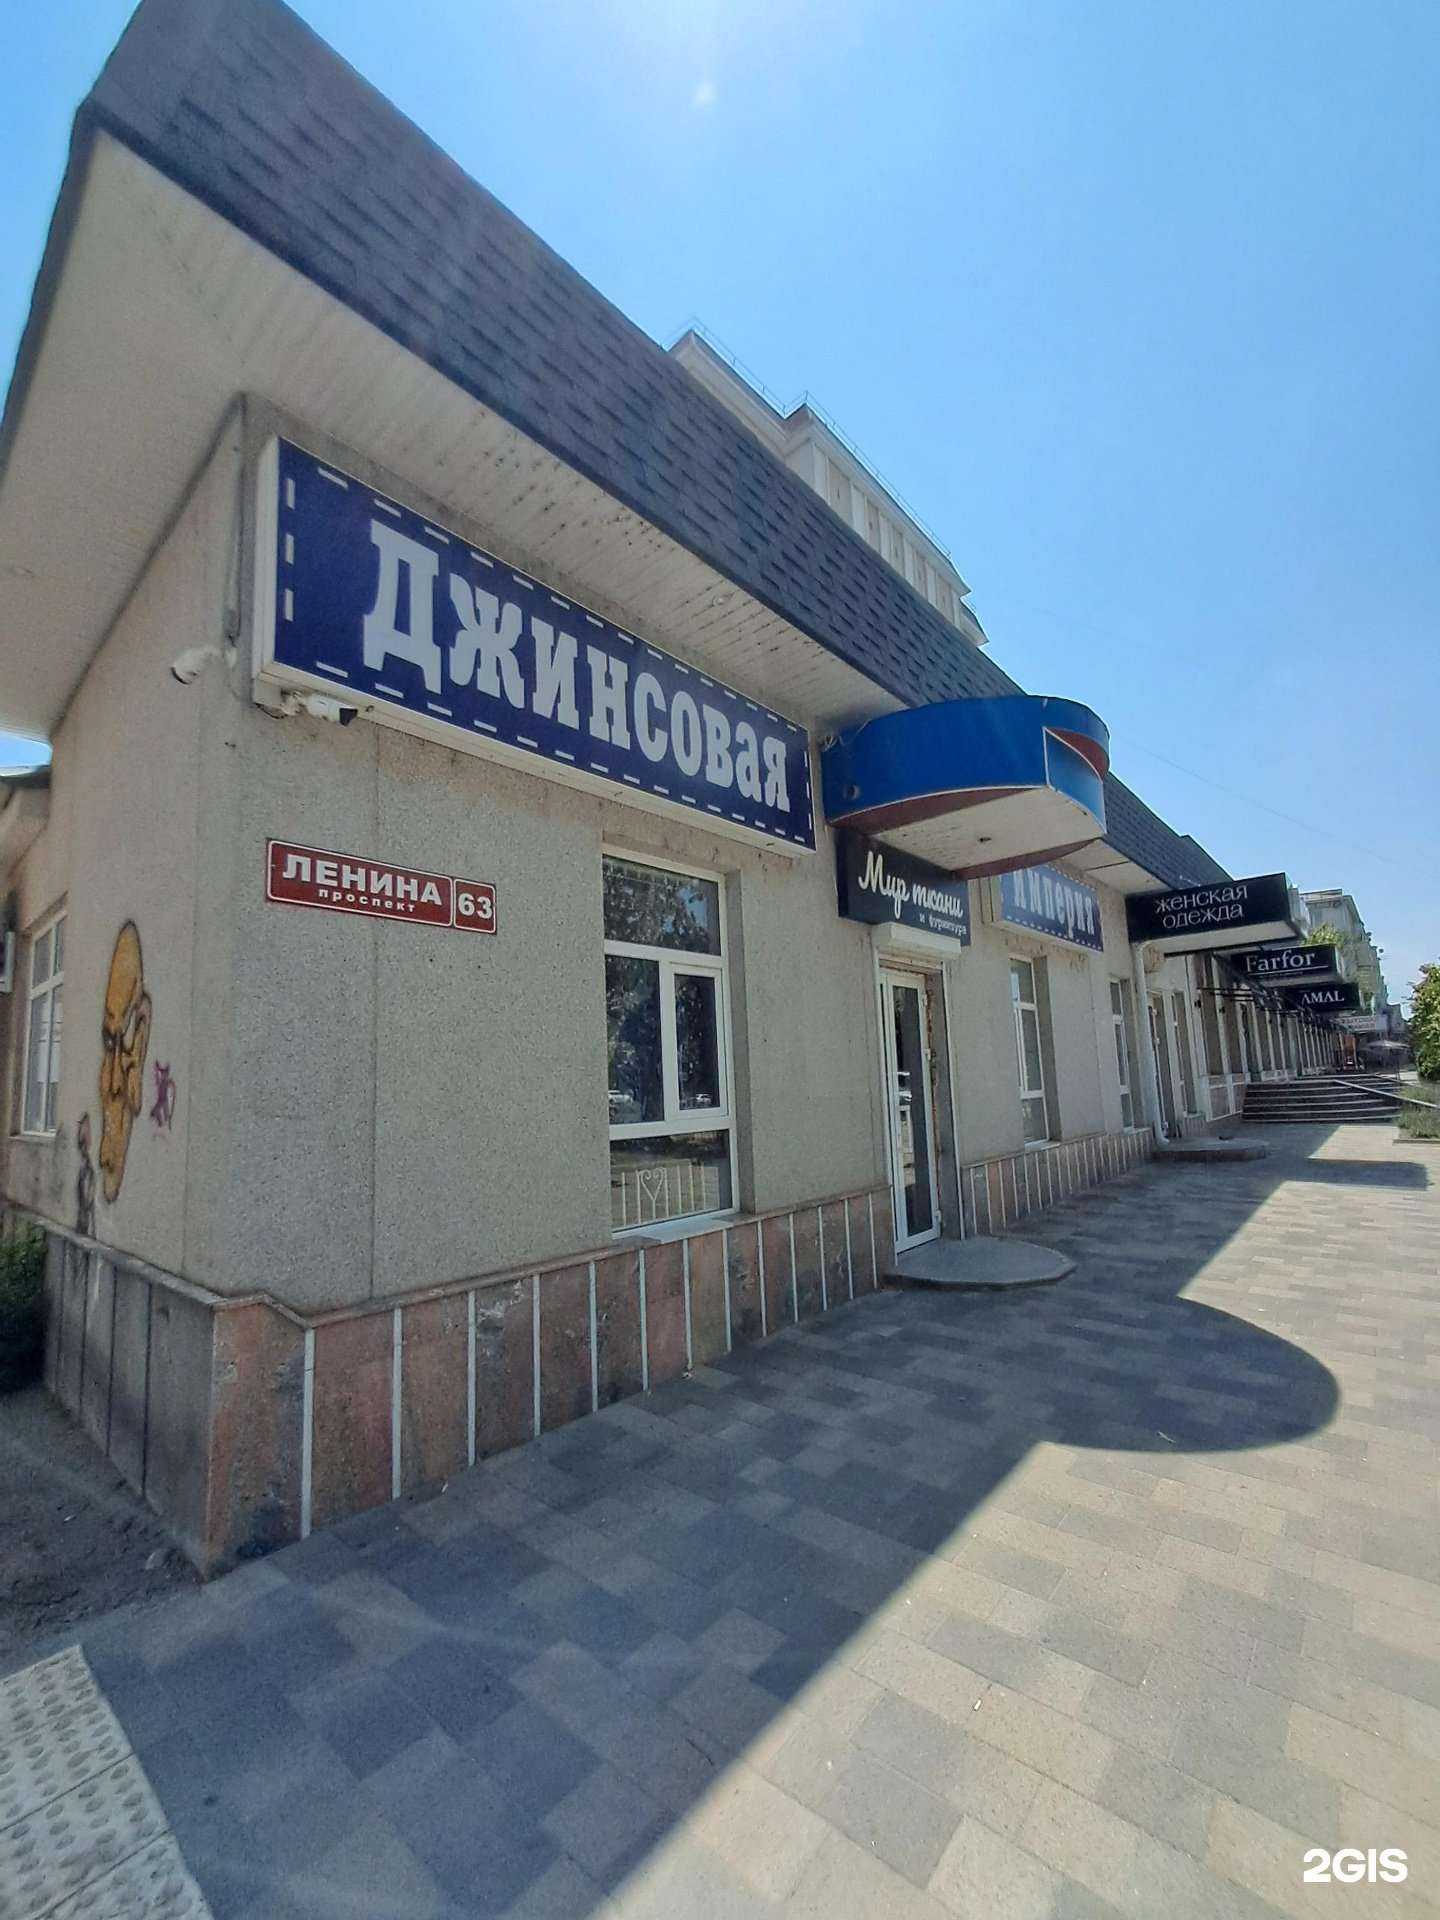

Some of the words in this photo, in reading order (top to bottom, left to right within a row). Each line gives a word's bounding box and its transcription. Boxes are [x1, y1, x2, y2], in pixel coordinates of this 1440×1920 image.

[362, 518, 791, 813] Джинсовая
[282, 853, 443, 906] ЛЕНИНА
[858, 850, 910, 919] Мир
[912, 882, 963, 918] ткани
[318, 888, 416, 913] проспект
[457, 892, 493, 919] 63
[1245, 949, 1316, 973] Farfor
